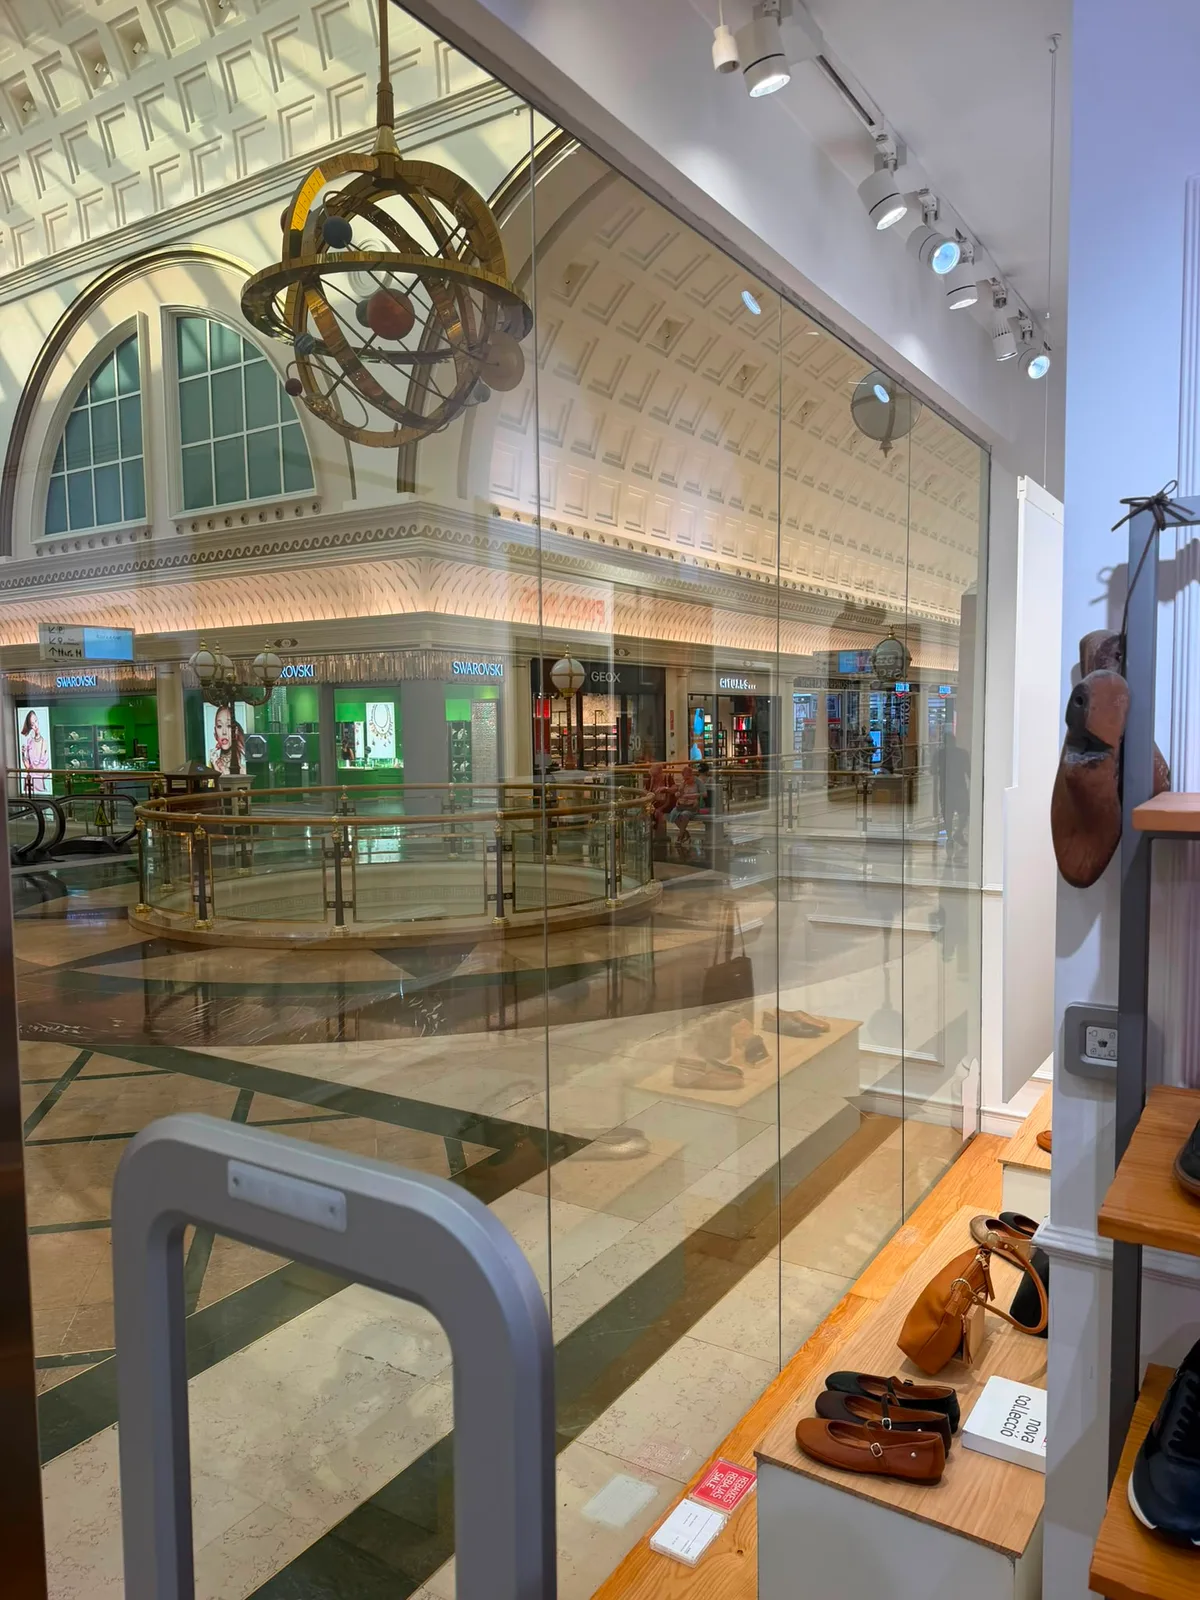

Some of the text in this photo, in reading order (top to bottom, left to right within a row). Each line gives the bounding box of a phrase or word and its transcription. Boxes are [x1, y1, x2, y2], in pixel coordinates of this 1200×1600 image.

[280, 664, 314, 678] ROVSKI
[452, 661, 503, 676] SWAROVSKI
[56, 675, 97, 688] SWAROVSKI
[591, 671, 621, 683] GEOX
[1021, 1418, 1042, 1443] nova
[705, 1471, 725, 1489] SALE
[712, 1470, 739, 1499] REBAJAS
[723, 1475, 749, 1504] REBAIXES
